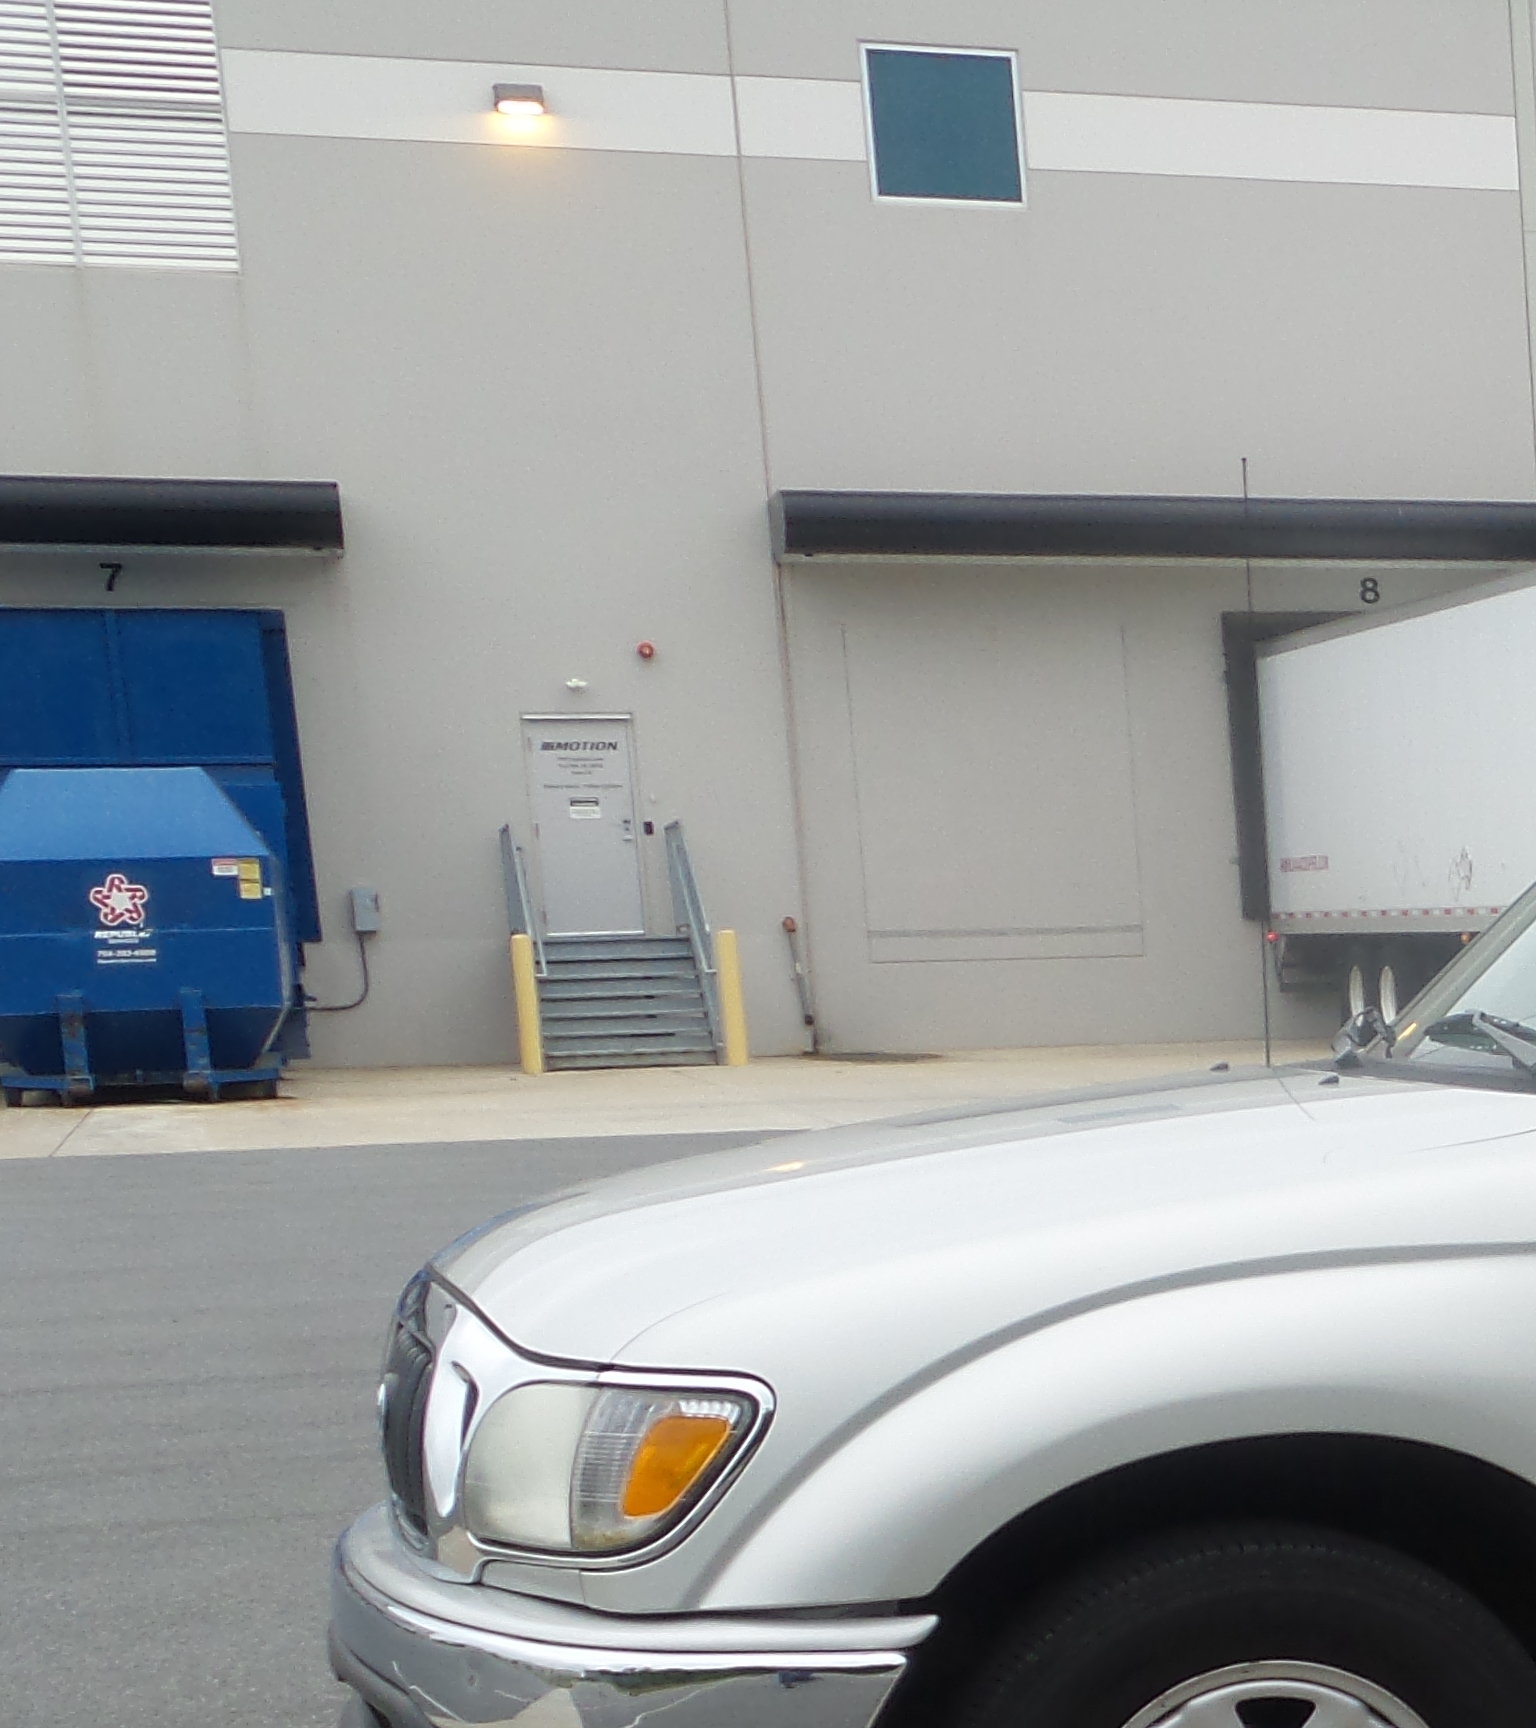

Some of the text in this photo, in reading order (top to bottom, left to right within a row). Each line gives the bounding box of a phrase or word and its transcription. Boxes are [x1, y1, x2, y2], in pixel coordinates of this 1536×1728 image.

[99, 563, 122, 592] 7
[1360, 577, 1380, 604] 8
[555, 741, 618, 751] MOTION
